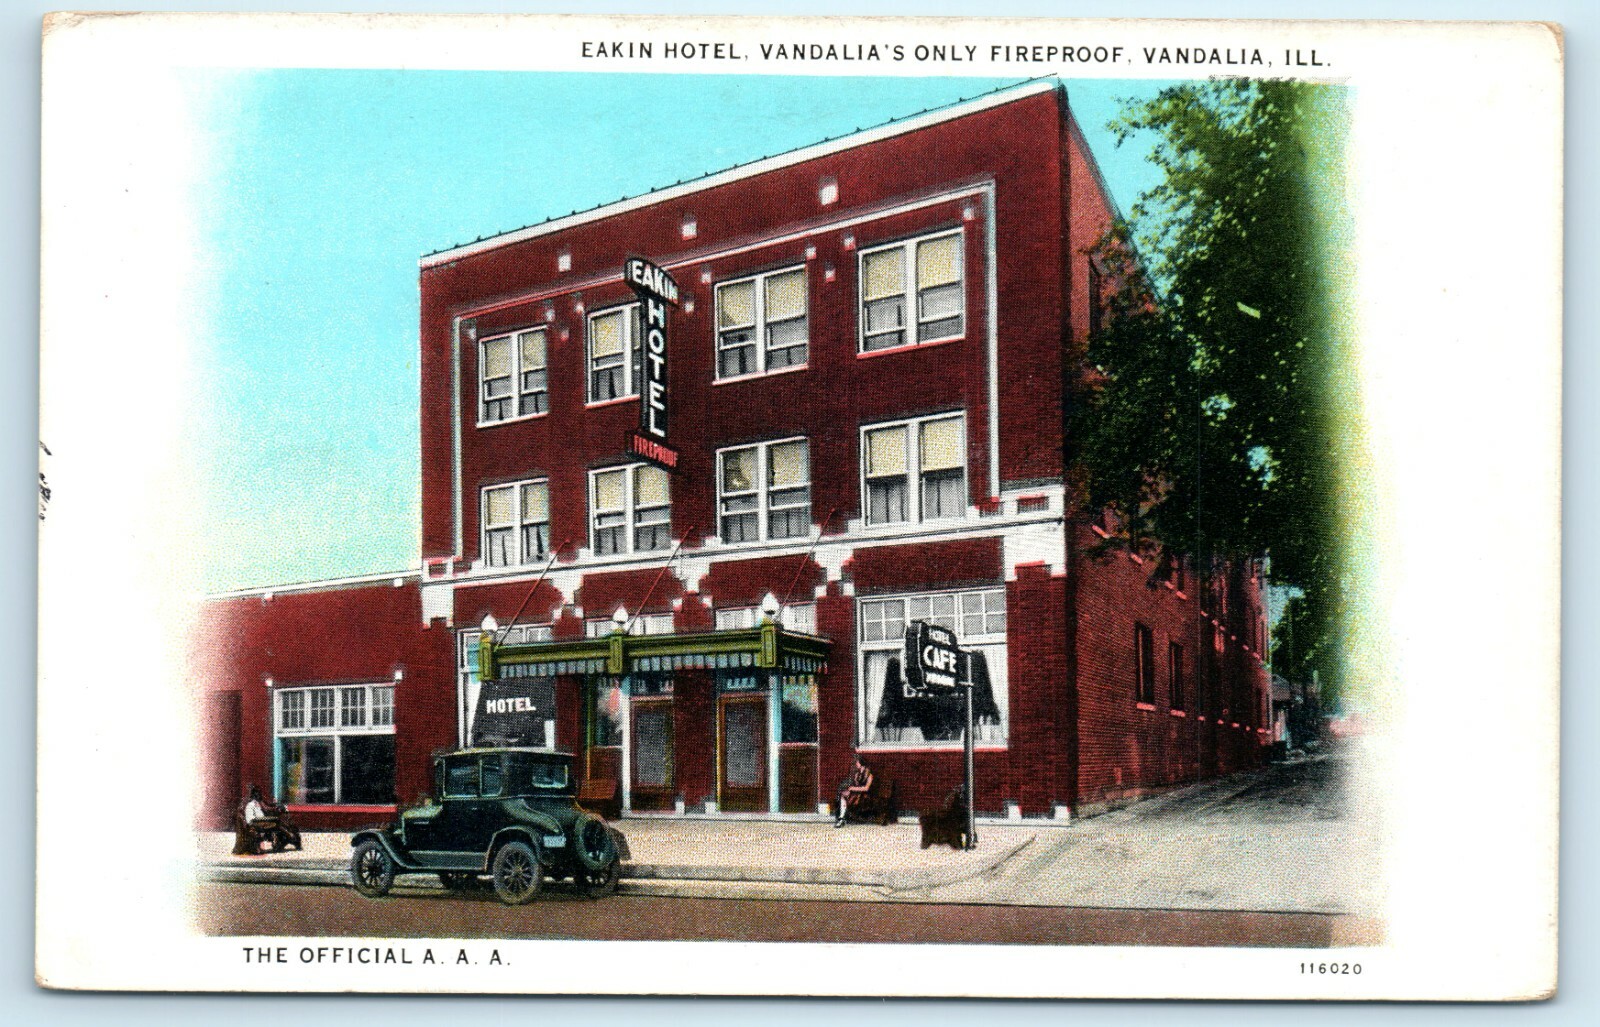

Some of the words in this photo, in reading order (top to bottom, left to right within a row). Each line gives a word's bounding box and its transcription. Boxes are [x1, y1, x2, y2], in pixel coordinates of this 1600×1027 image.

[582, 42, 652, 59] EAKIN
[664, 42, 748, 61] HOTEL,
[760, 43, 905, 61] VANDALIA'S
[914, 45, 978, 62] ONLY
[991, 45, 1131, 65] FIREPROOF,
[1143, 47, 1272, 67] VANDALIA,
[1285, 49, 1333, 67] ILL.
[631, 259, 679, 304] EAKIN
[647, 298, 666, 438] HOTEL
[923, 645, 957, 673] CAFE
[486, 697, 537, 714] HOTEL
[242, 947, 288, 964] THE
[299, 947, 413, 965] OFFICIAL
[423, 948, 445, 965] A.
[456, 948, 478, 966] A.
[489, 949, 511, 966] A.
[1300, 962, 1362, 975] 116020
